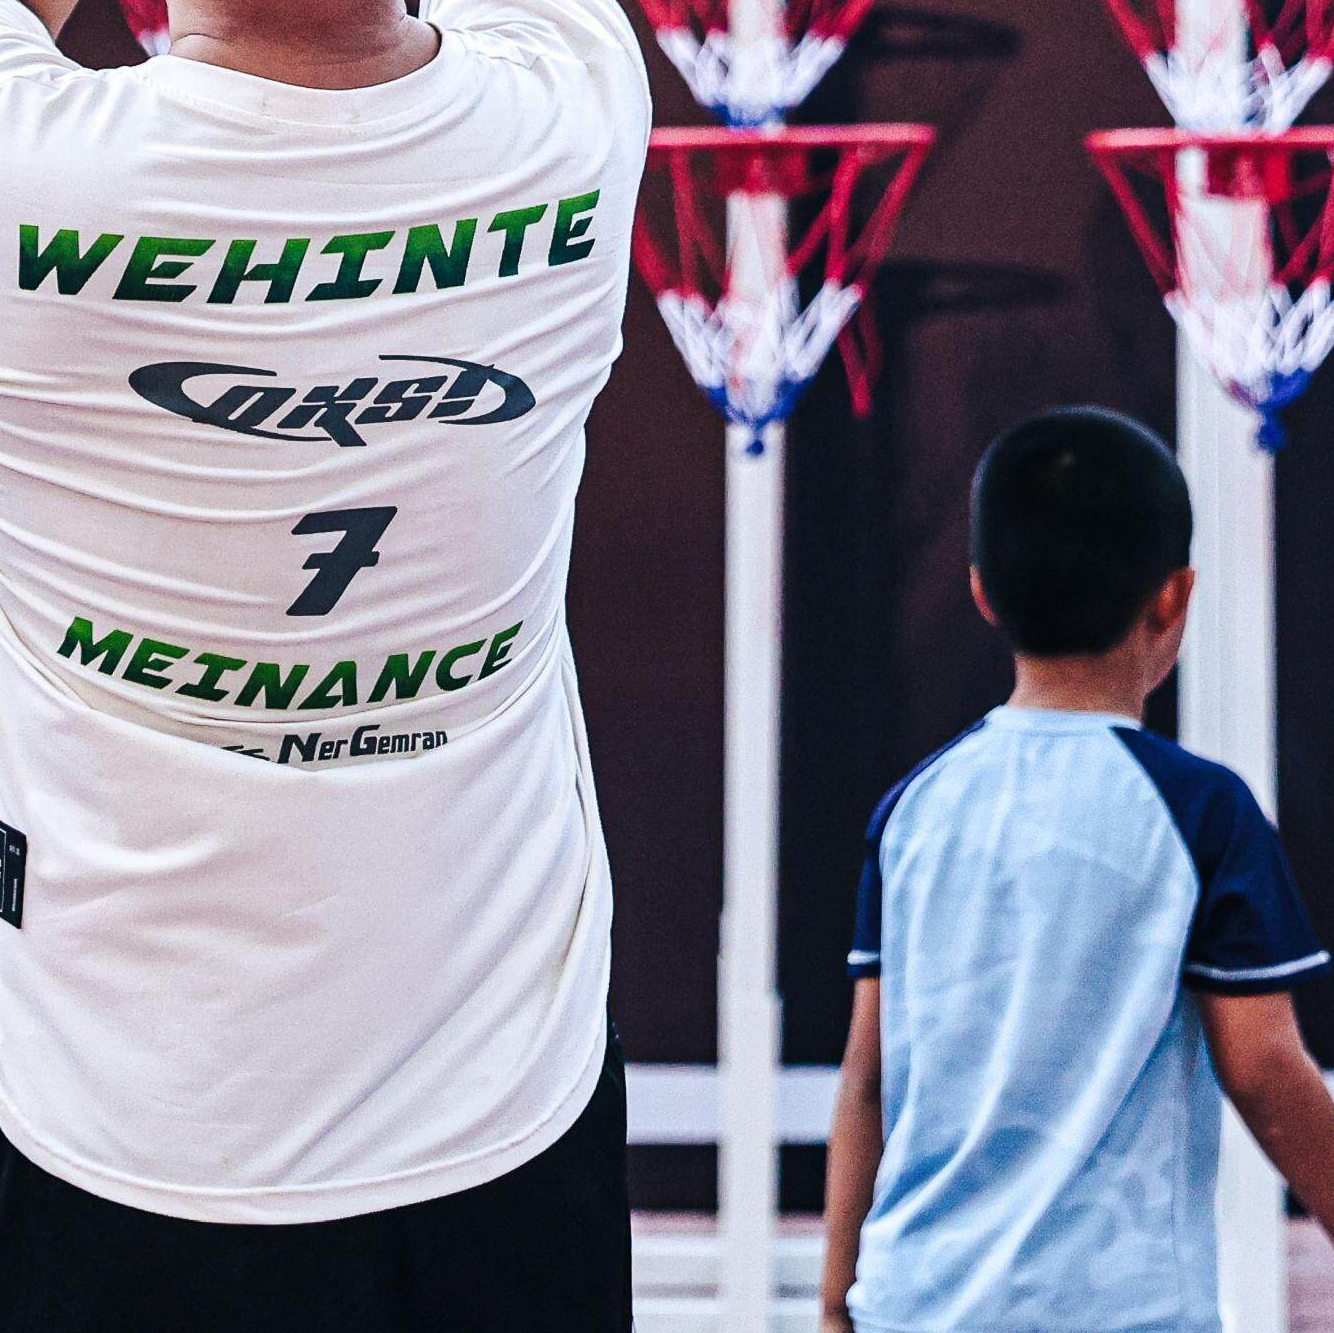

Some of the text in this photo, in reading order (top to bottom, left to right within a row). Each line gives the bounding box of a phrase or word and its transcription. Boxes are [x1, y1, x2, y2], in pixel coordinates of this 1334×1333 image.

[18, 189, 600, 305] WEHINTE
[285, 505, 398, 617] 7
[56, 615, 524, 711] MEINANCE
